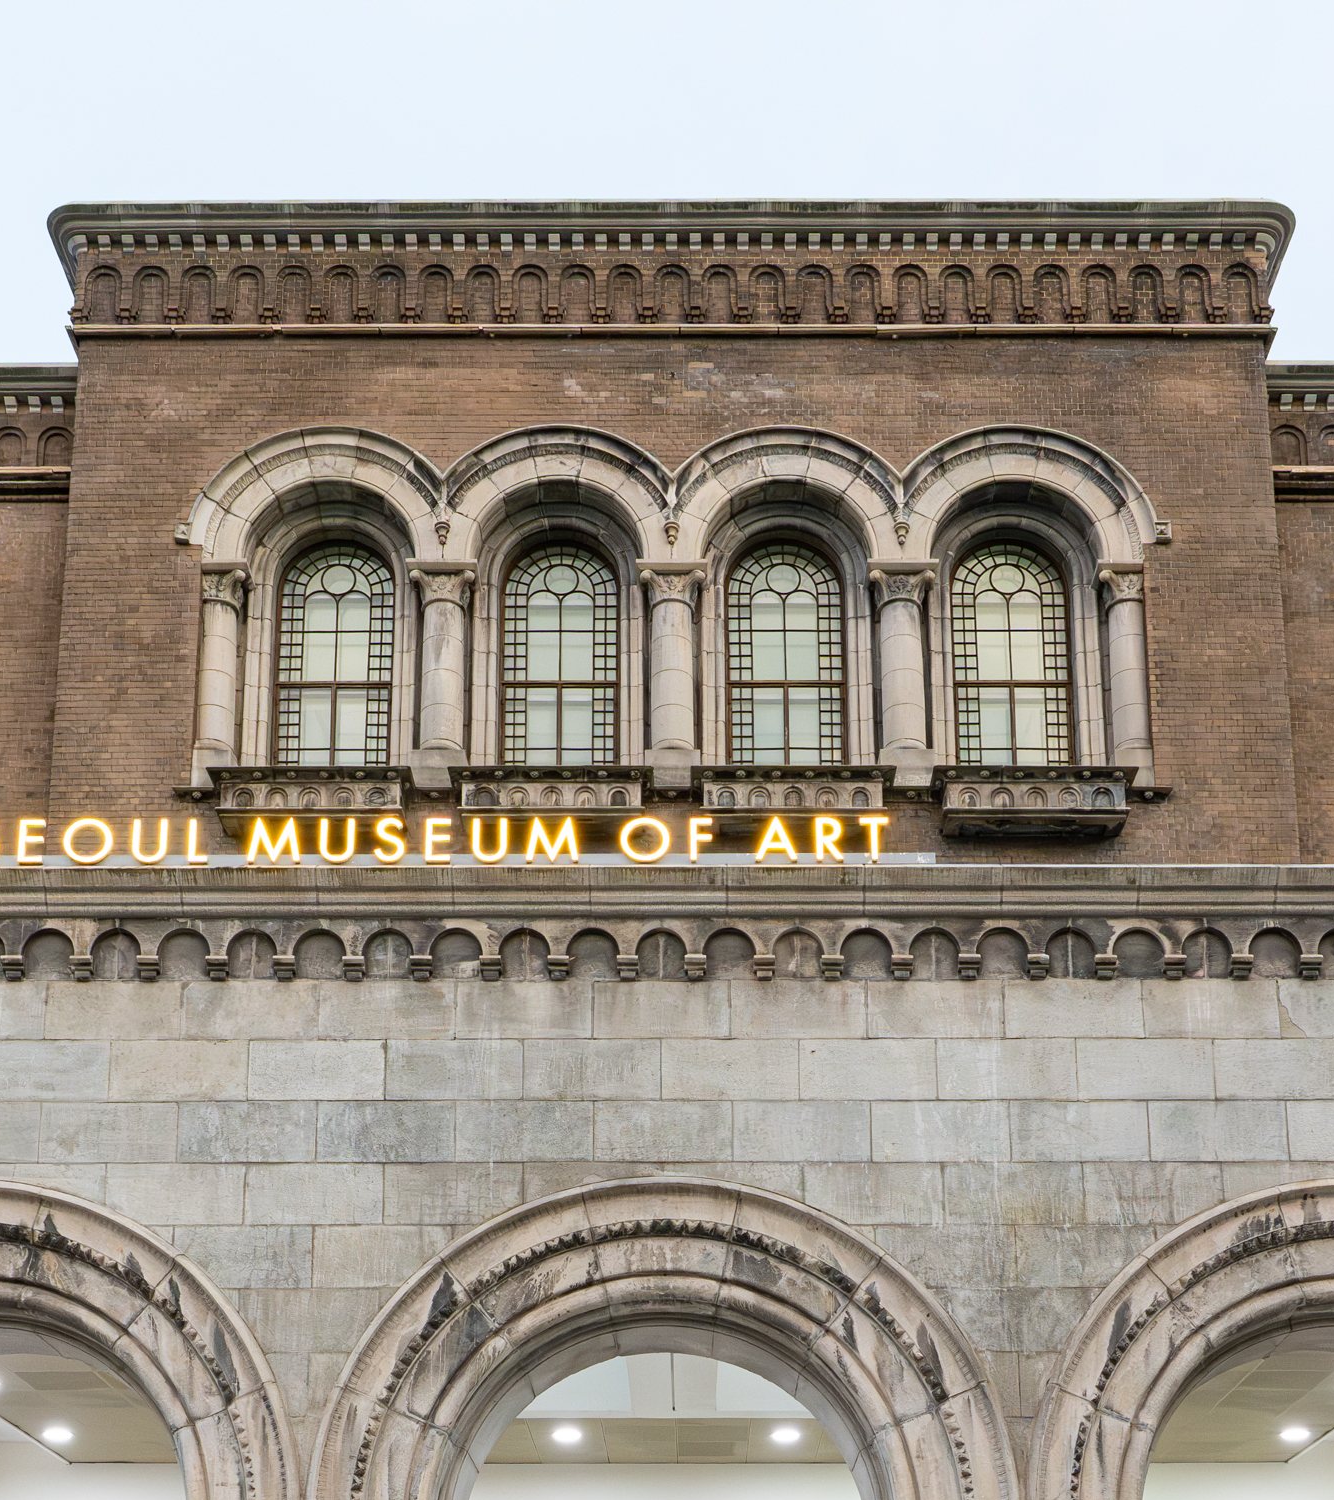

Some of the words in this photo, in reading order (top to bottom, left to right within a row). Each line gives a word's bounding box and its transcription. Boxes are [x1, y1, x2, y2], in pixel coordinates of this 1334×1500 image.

[246, 815, 581, 864] MUSEUM
[619, 815, 714, 863] OF
[753, 815, 890, 863] ART
